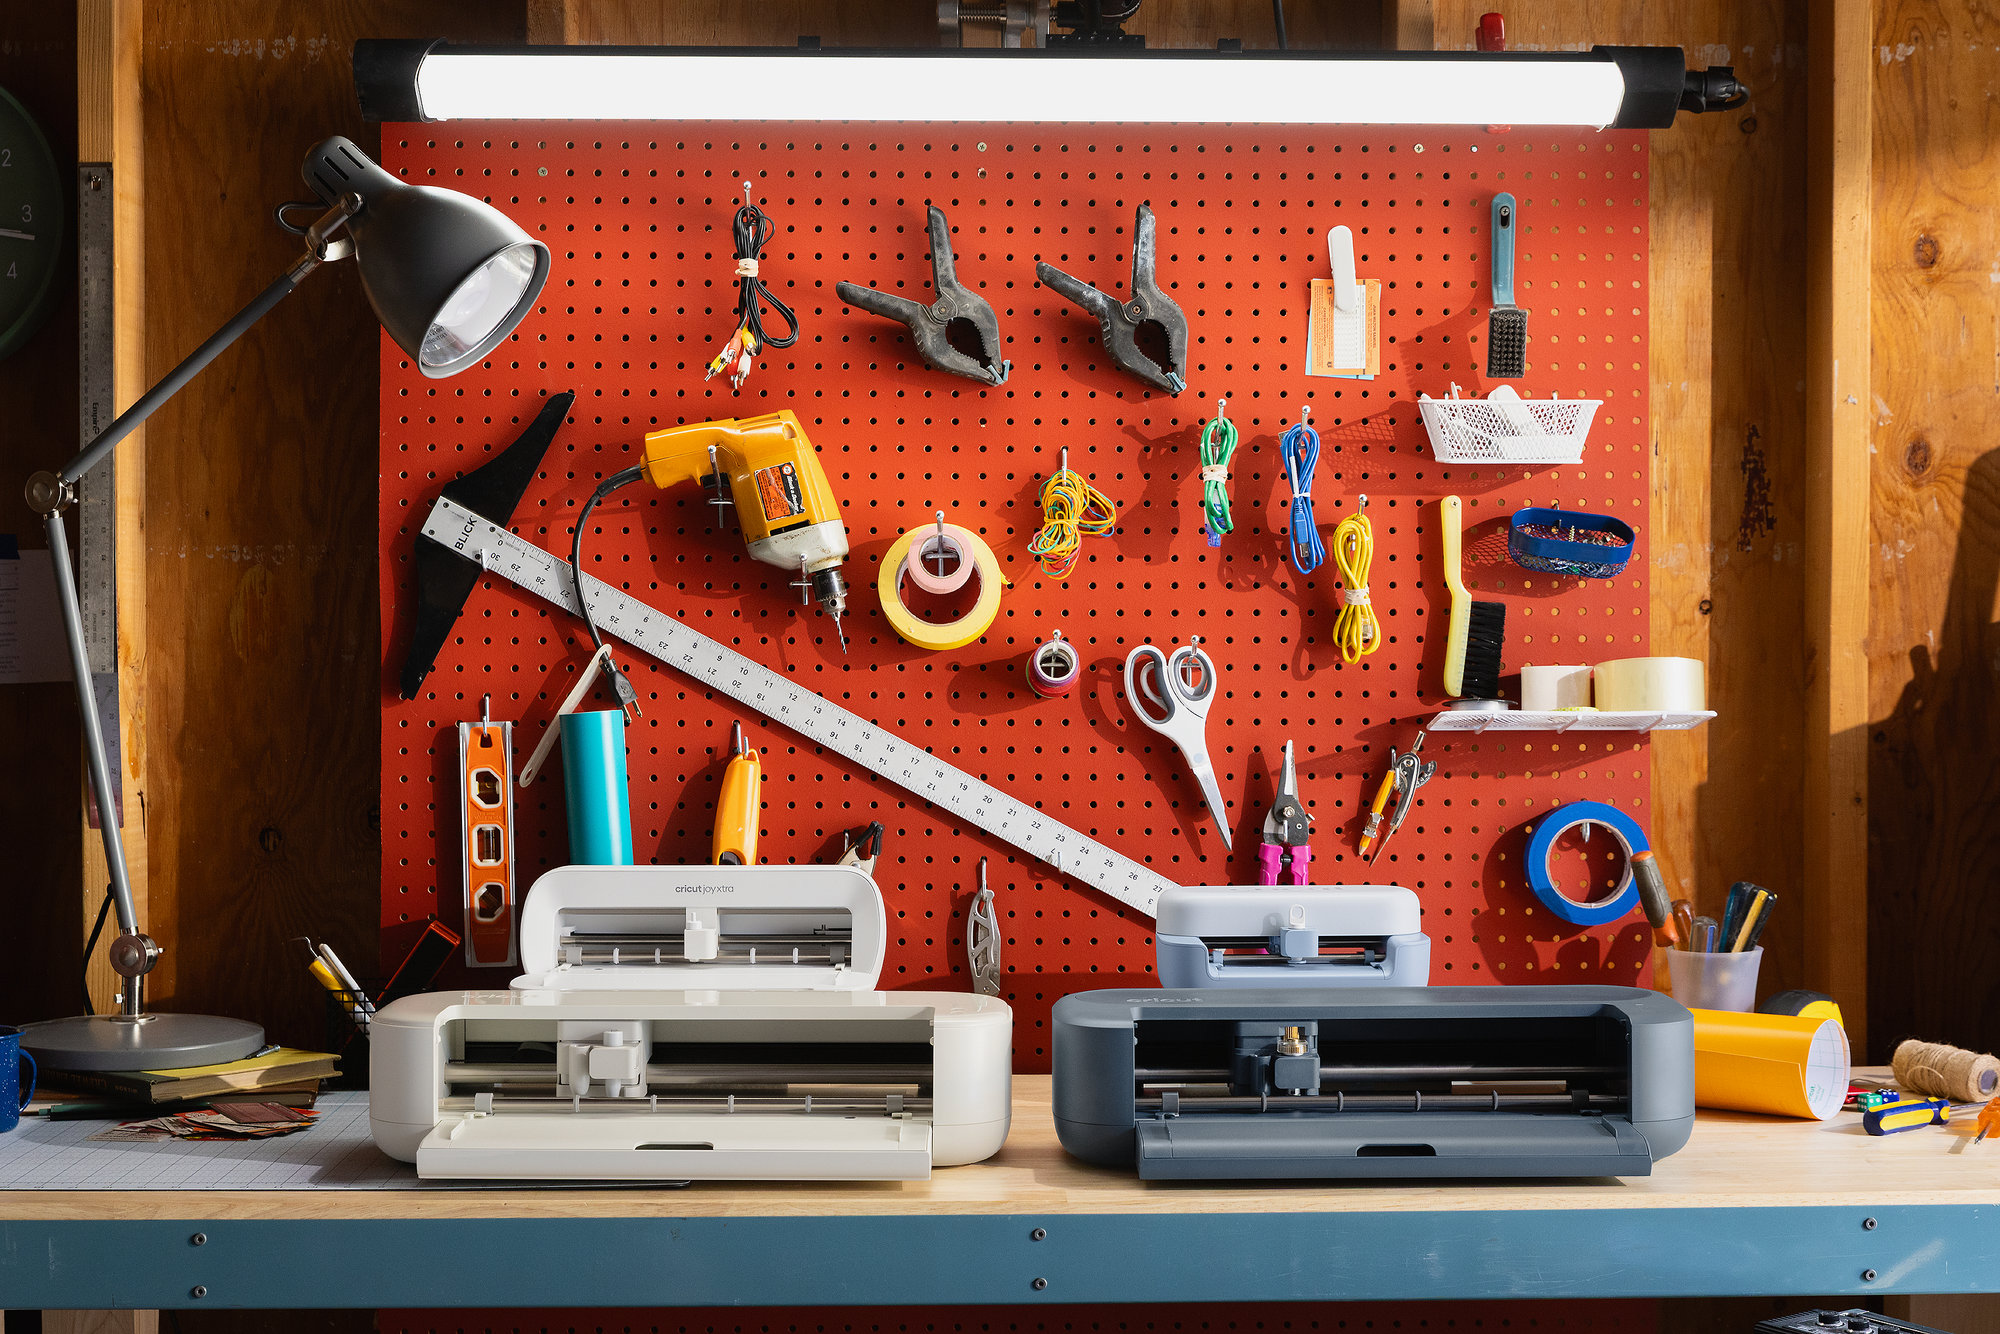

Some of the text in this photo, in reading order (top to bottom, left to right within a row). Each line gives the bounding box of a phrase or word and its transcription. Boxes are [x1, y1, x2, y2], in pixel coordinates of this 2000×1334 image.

[1, 149, 12, 167] 2
[21, 205, 32, 222] 3
[7, 261, 17, 279] 4
[454, 517, 477, 551] BLICK
[491, 553, 500, 561] 30
[511, 564, 521, 572] 29
[536, 576, 545, 585] 28
[560, 589, 571, 598] 27
[609, 615, 619, 623] 25
[635, 629, 644, 637] 24
[659, 641, 668, 649] 23
[683, 654, 693, 662] 22
[707, 667, 717, 675] 21
[732, 680, 741, 688] 20
[757, 692, 766, 701] 19
[781, 705, 790, 713] 18
[830, 730, 839, 739] 16
[854, 743, 863, 752] 15
[879, 756, 888, 765] 14
[903, 769, 912, 778] 13
[927, 781, 936, 790] 12
[952, 794, 960, 803] 11
[976, 807, 985, 816] 10
[1001, 821, 1008, 829] 9
[1025, 834, 1033, 842] 8
[1050, 847, 1056, 855] 7
[1074, 859, 1081, 867] 6
[1098, 872, 1105, 880] 5
[497, 539, 504, 547] 0
[544, 564, 551, 572] 2
[618, 603, 625, 611] 5
[668, 628, 674, 636] 7
[691, 641, 699, 650] 8
[716, 654, 724, 662] 9
[740, 666, 749, 675] 10
[765, 680, 774, 688] 11
[789, 692, 798, 701] 12
[814, 705, 823, 714] 13
[838, 718, 847, 726] 14
[862, 731, 871, 740] 15
[887, 744, 896, 752] 16
[935, 769, 944, 778] 18
[960, 782, 969, 791] 19
[983, 795, 992, 803] 20
[1008, 807, 1017, 816] 21
[1031, 821, 1041, 830] 22
[1056, 834, 1065, 842] 23
[1080, 846, 1089, 854] 24
[1104, 859, 1114, 867] 25
[1129, 872, 1138, 880] 26
[675, 884, 702, 893] cricut
